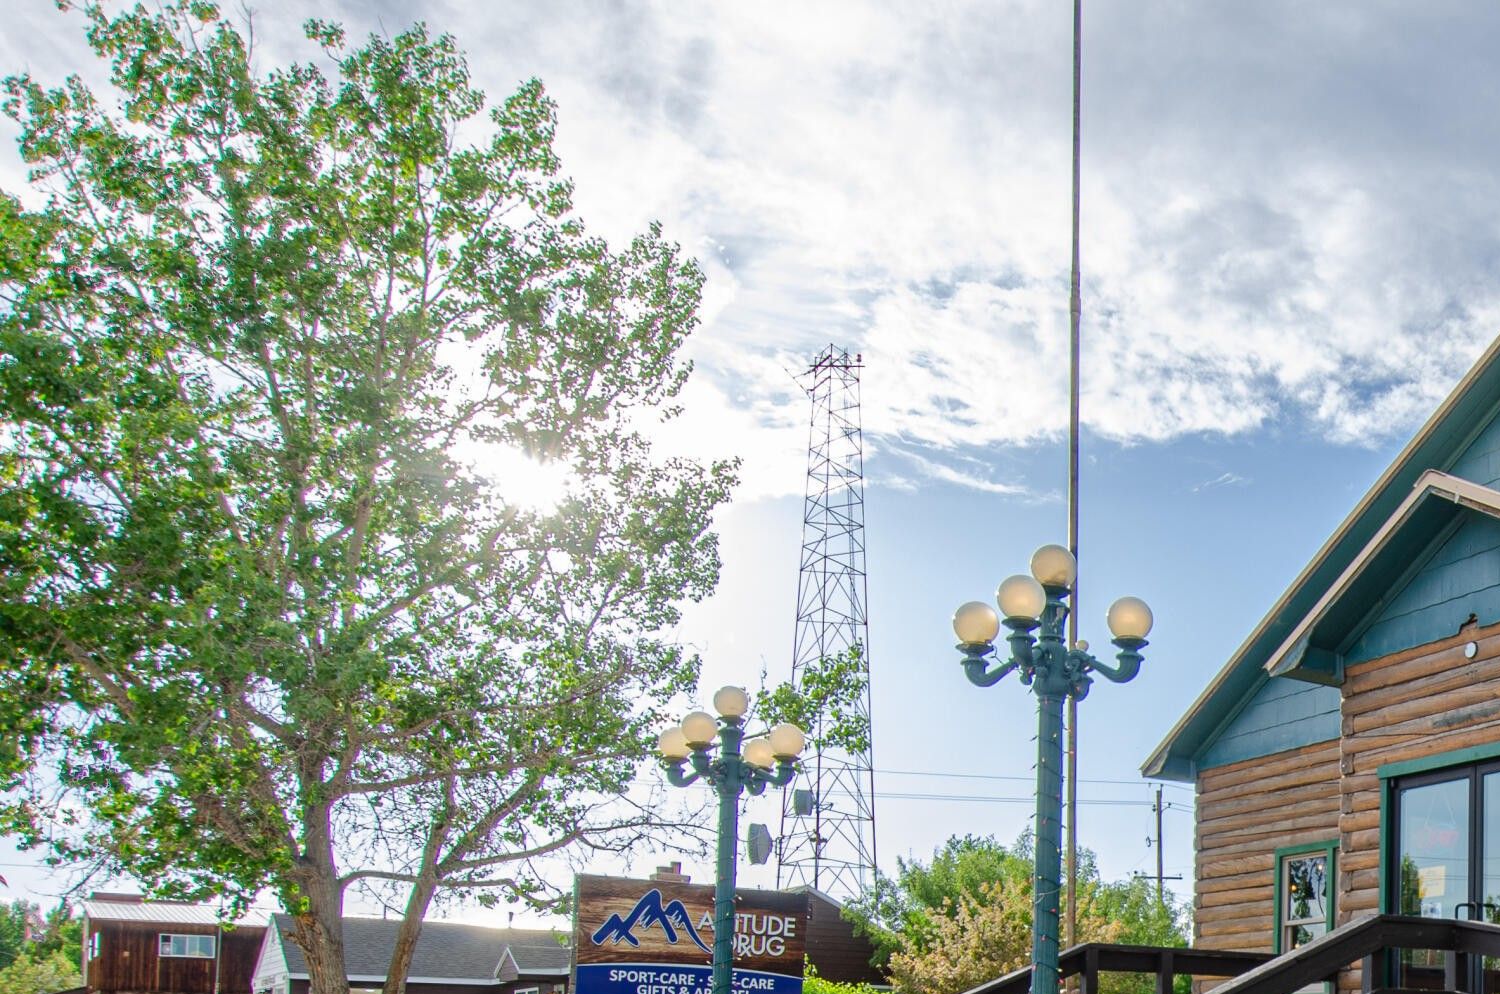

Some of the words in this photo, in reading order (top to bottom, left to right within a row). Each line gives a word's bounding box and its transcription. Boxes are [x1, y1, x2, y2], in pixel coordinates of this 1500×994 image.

[697, 910, 796, 937] AITUDE
[609, 969, 695, 986] SPORT-CARE
[707, 975, 775, 990] S-CARE
